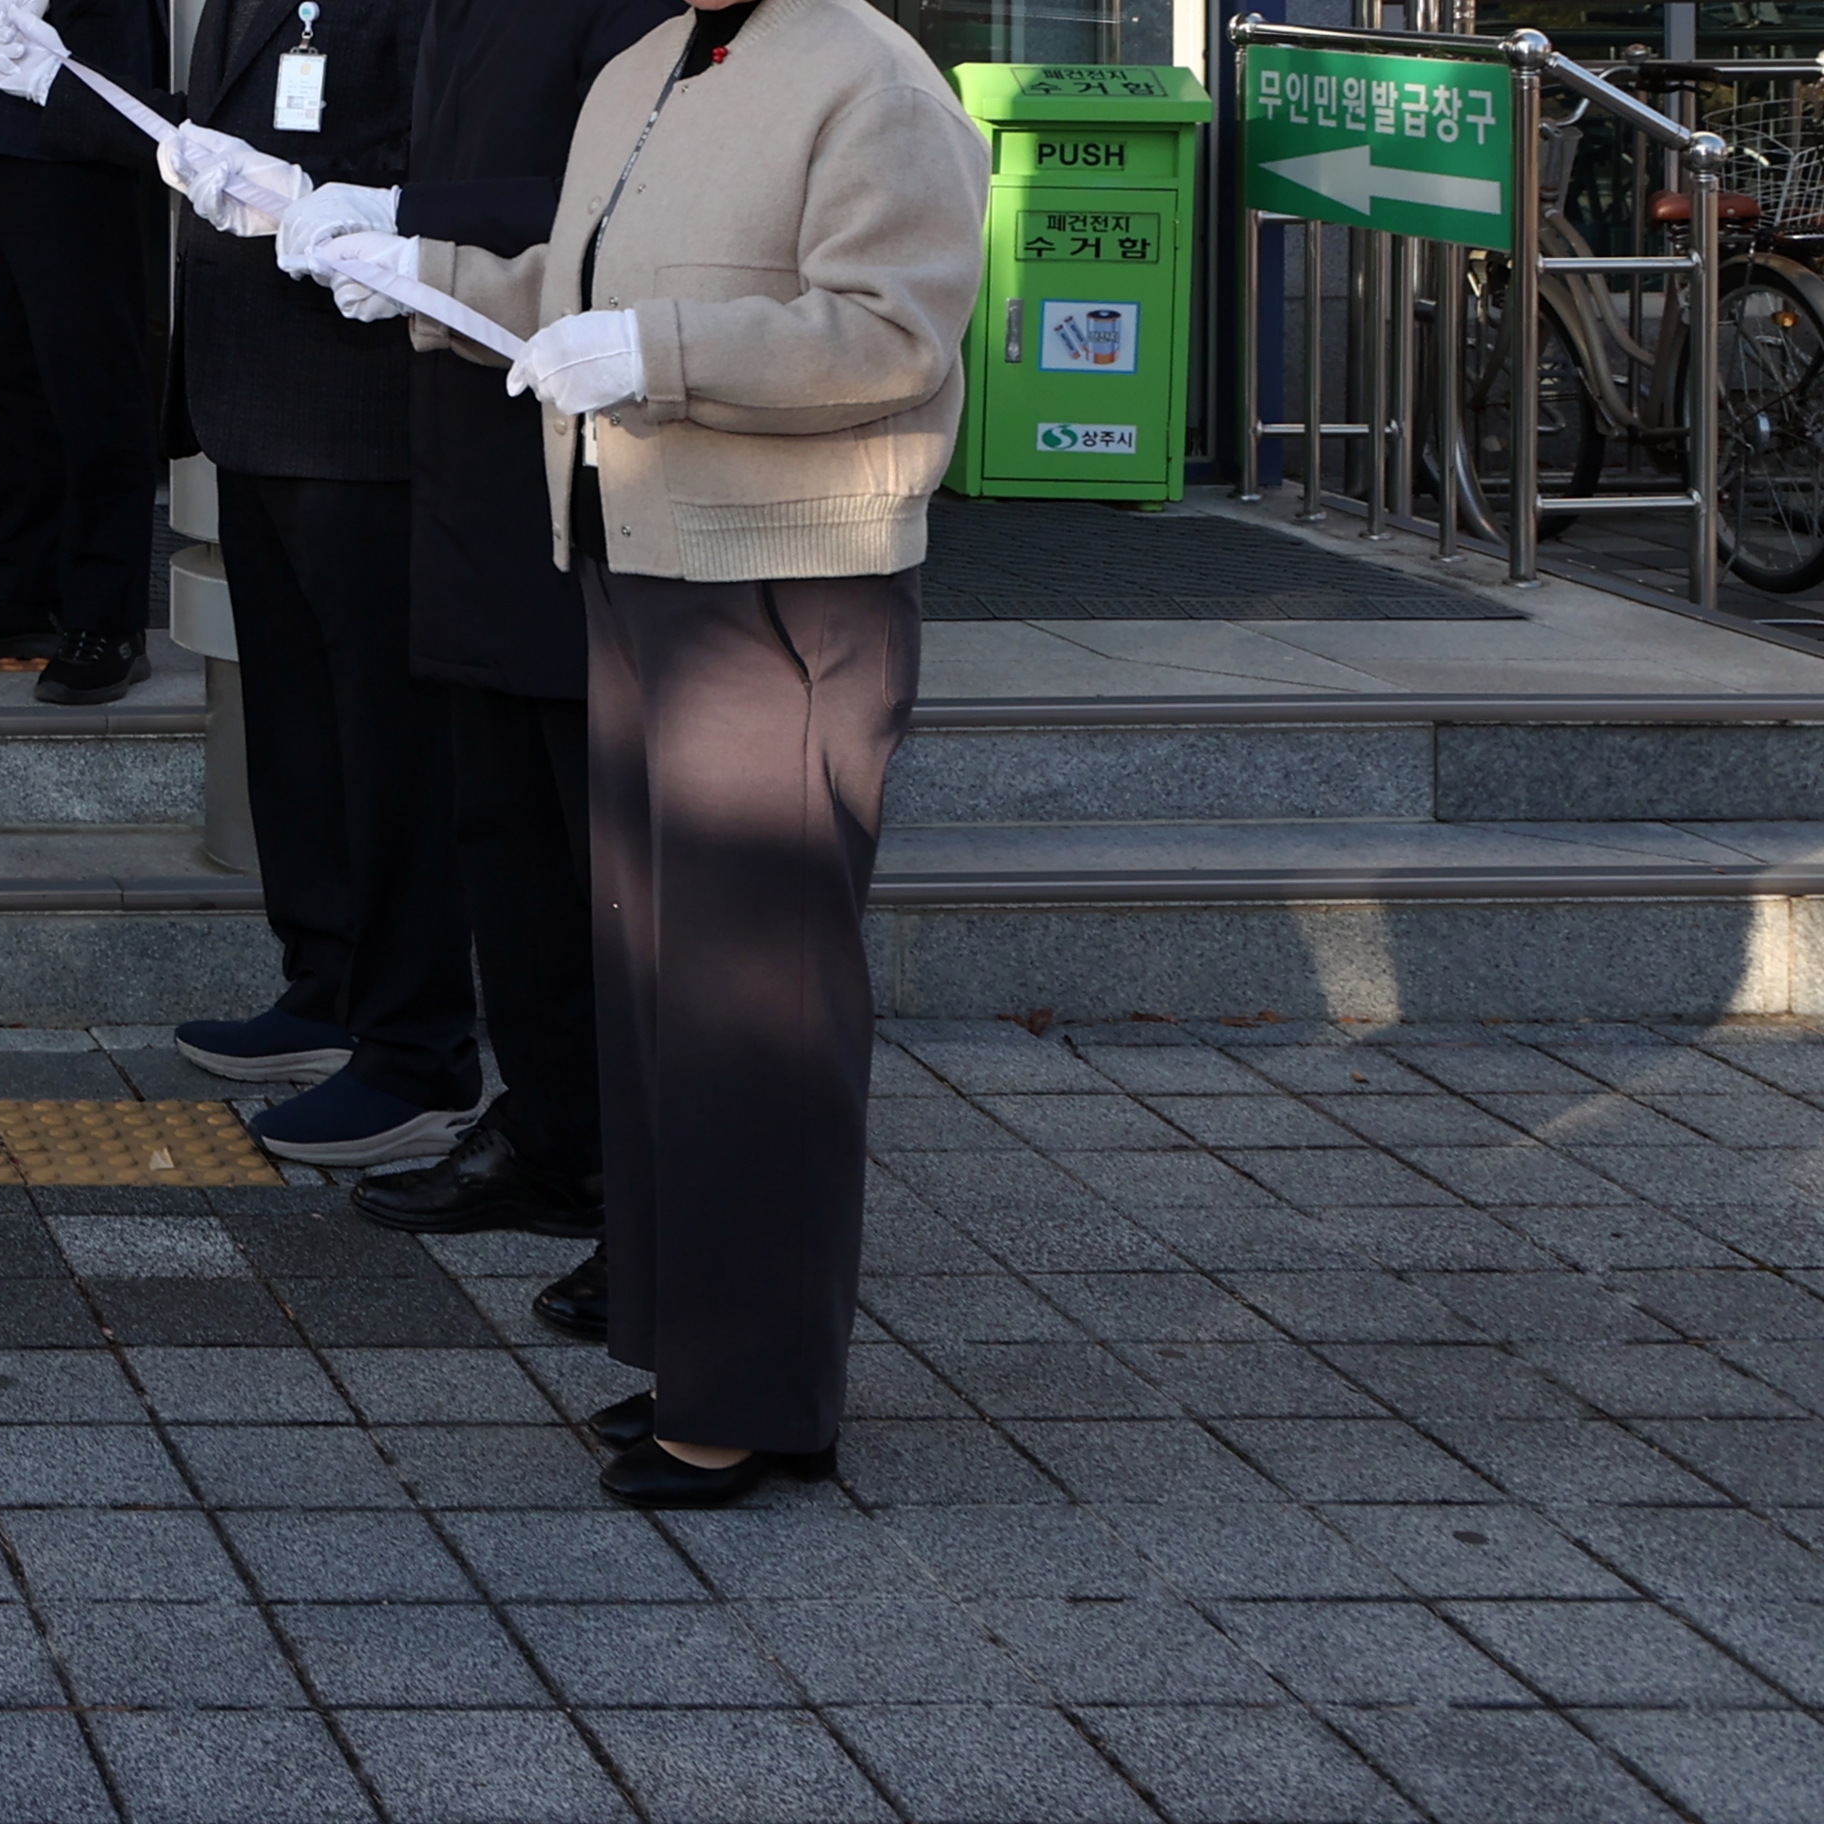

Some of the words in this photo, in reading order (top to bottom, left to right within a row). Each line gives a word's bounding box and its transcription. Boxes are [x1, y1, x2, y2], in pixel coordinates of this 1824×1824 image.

[1030, 80, 1156, 96] 수거함
[1257, 69, 1497, 146] 무인민원발급창구
[1036, 142, 1126, 167] PUSH
[1023, 236, 1152, 260] 수거함
[1081, 430, 1133, 449] 상주시
